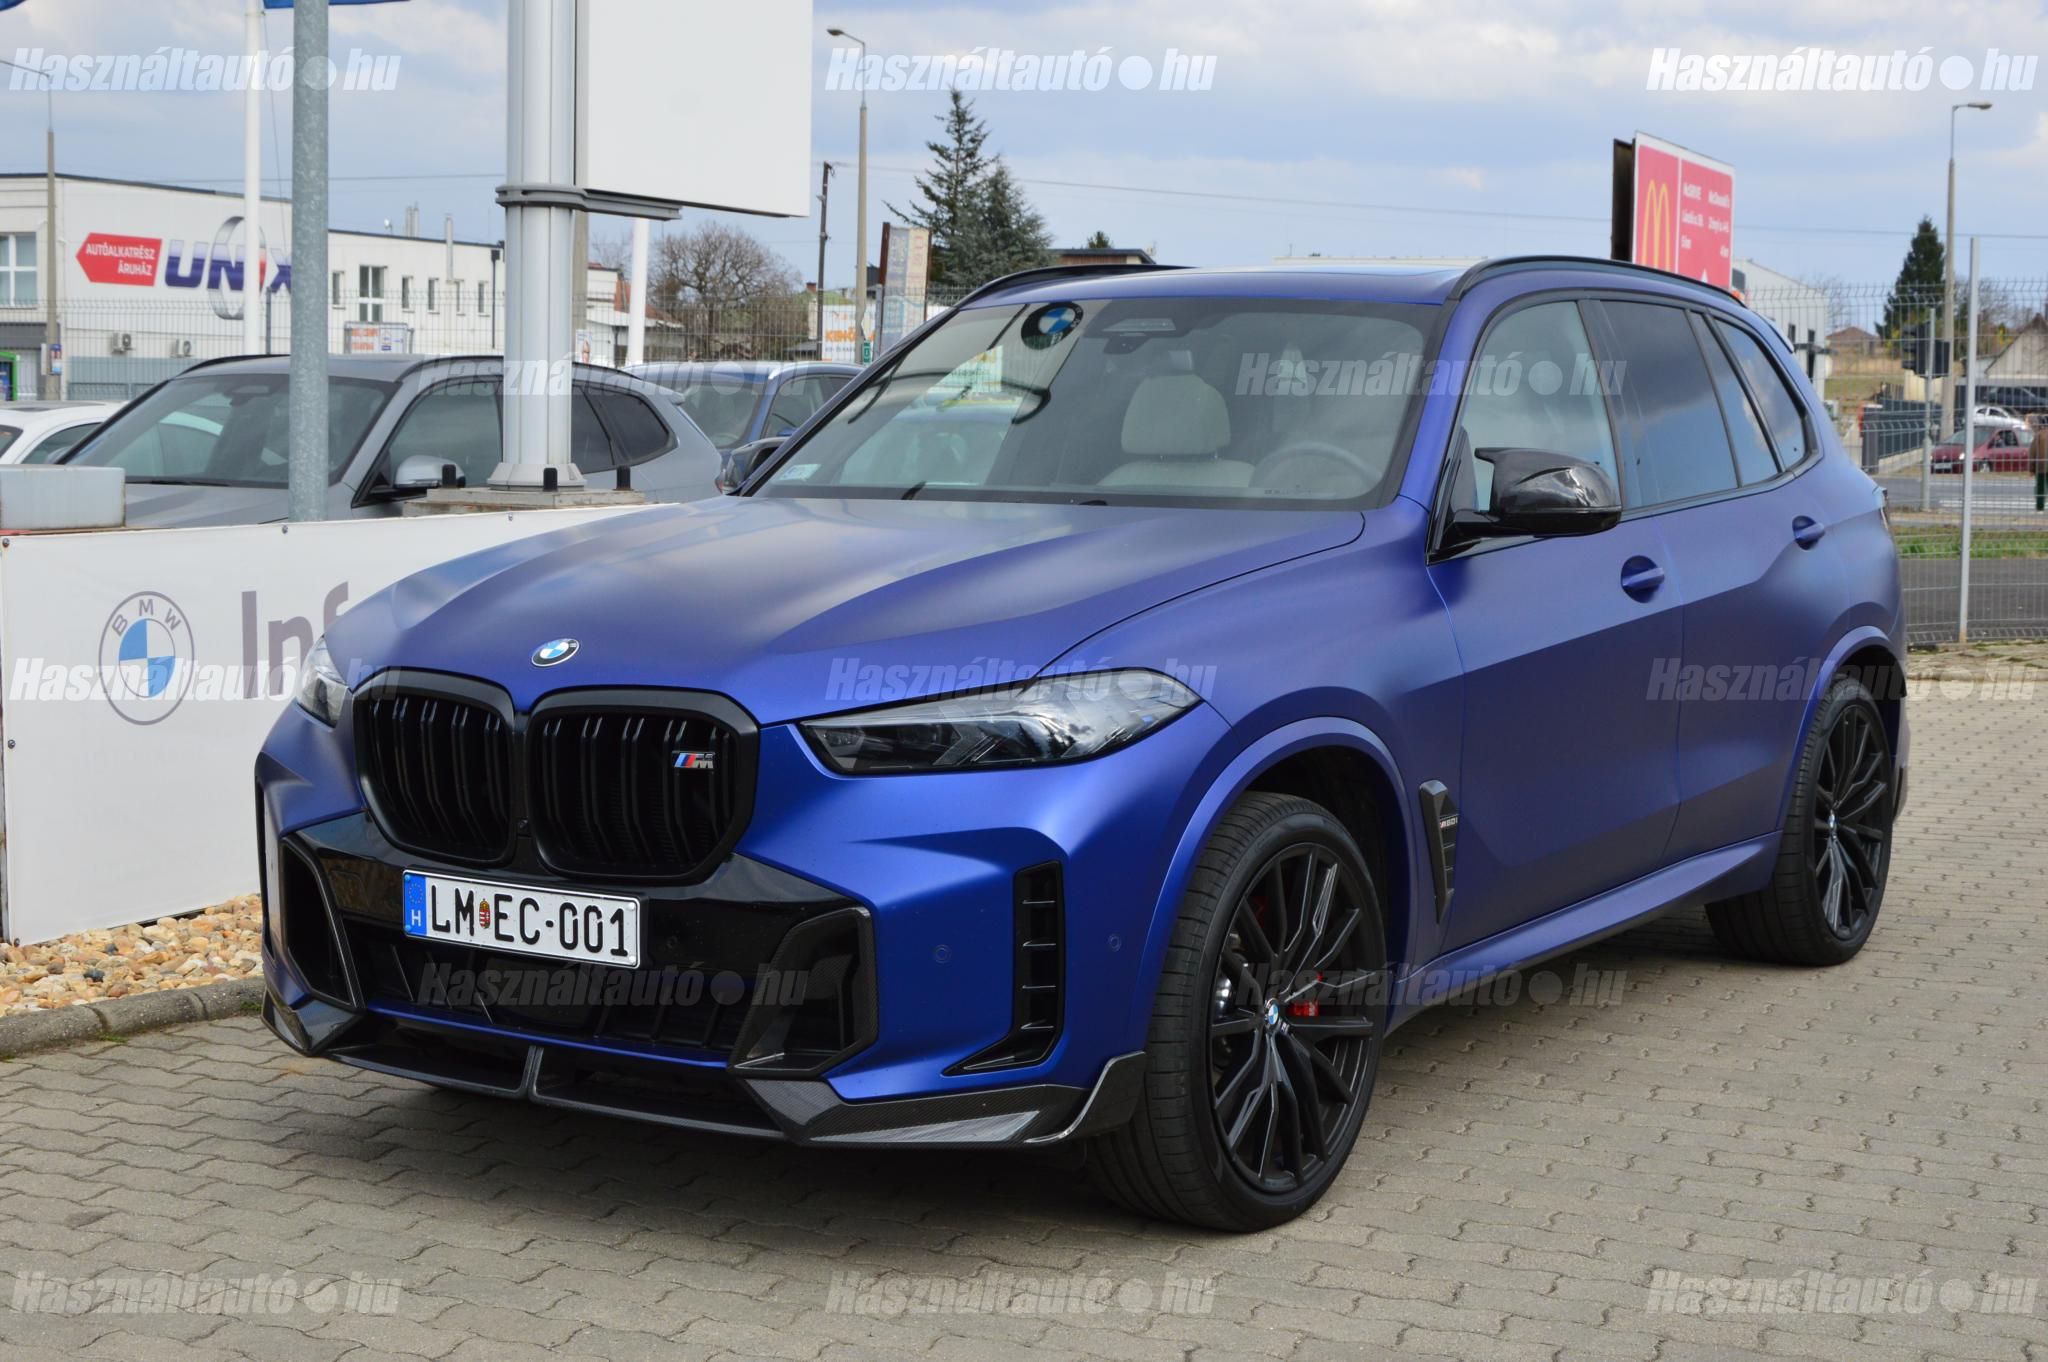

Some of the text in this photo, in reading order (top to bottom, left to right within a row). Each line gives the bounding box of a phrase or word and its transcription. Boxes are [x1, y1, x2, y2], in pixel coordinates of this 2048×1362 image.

[85, 241, 156, 261] AUTÓALKATRÉSZ
[117, 260, 153, 277] ÁRUHÁZ
[165, 239, 292, 295] UNX
[111, 597, 182, 637] BMW
